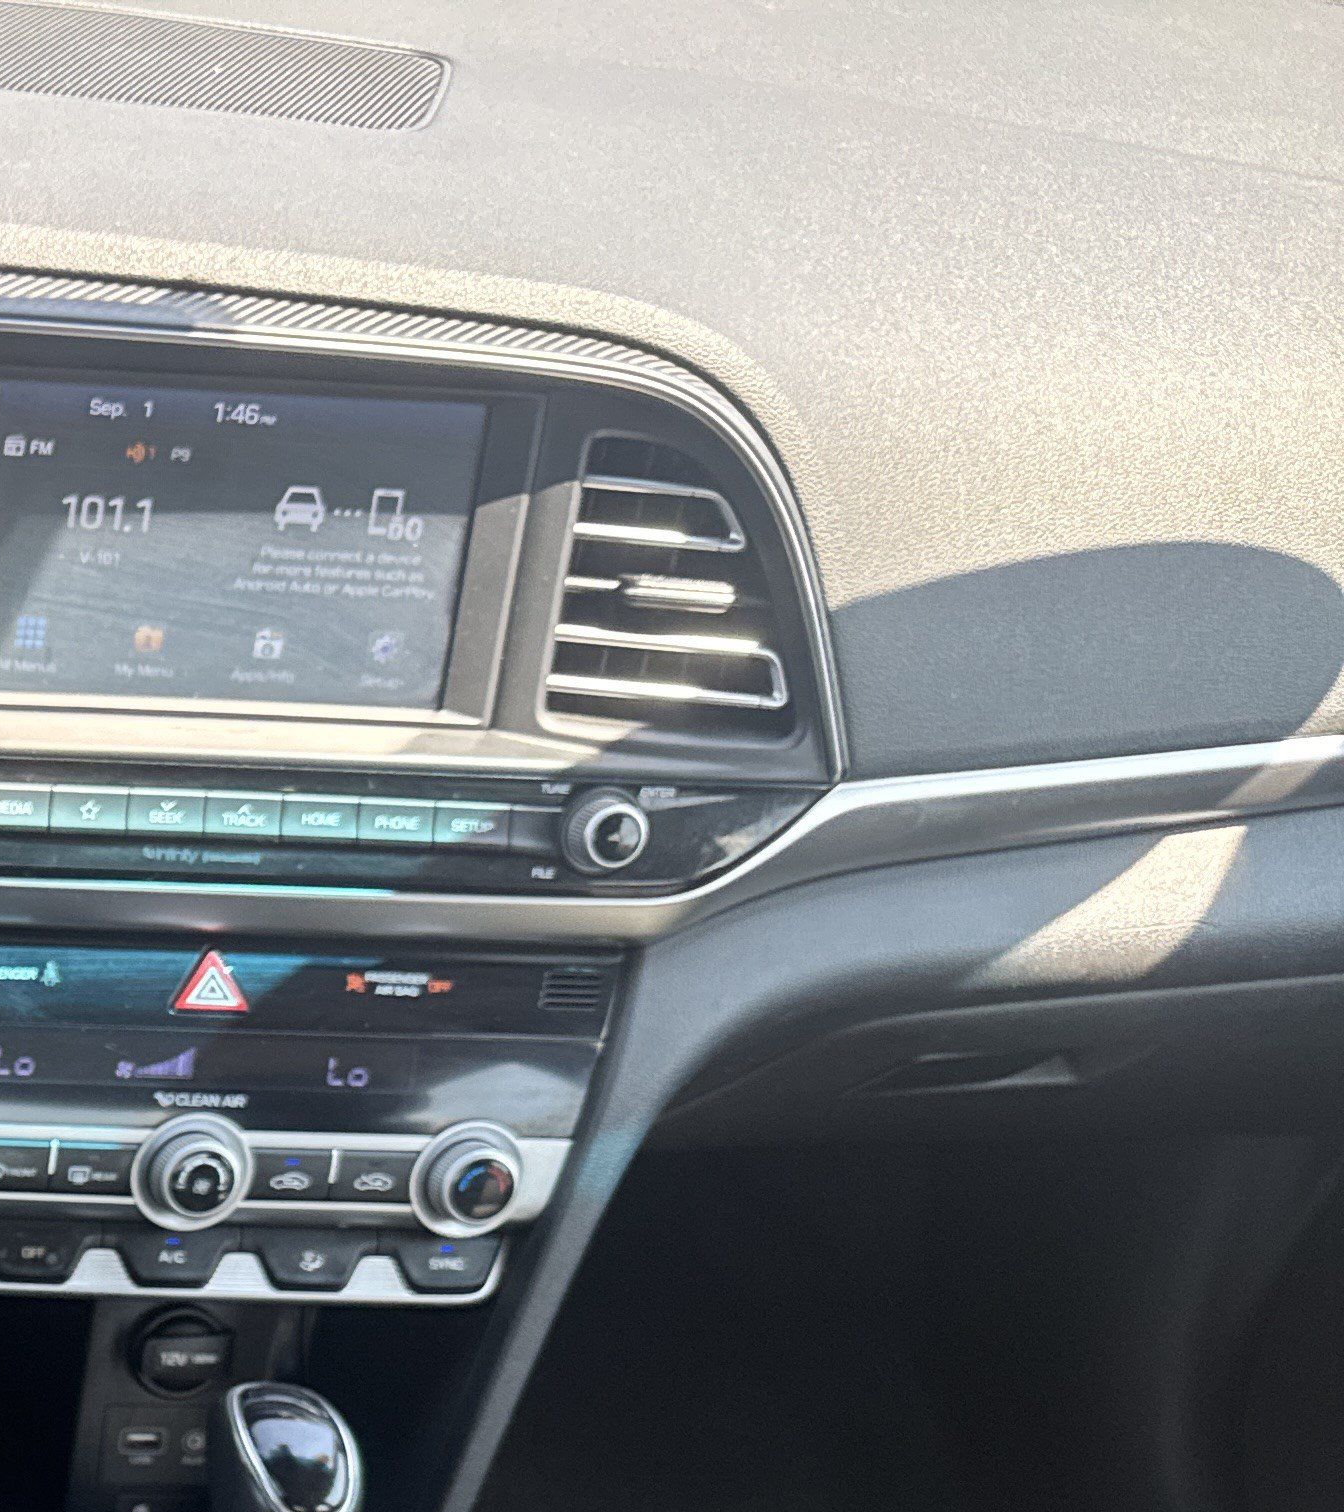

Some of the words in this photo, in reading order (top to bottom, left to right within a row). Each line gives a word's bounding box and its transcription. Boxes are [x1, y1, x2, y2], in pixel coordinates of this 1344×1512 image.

[89, 397, 127, 419] Sep.
[30, 440, 56, 456] FM
[62, 495, 154, 533] 101.1
[148, 810, 185, 825] SEEK
[221, 812, 266, 827] TRACK
[301, 812, 342, 828] HOME
[374, 815, 421, 831] PHONE
[451, 818, 495, 834] SETUP
[175, 1093, 219, 1108] CLEAN
[222, 1094, 248, 1108] AIR
[21, 1247, 46, 1259] OFF
[158, 1251, 187, 1264] A/C
[429, 1257, 463, 1271] SYNC
